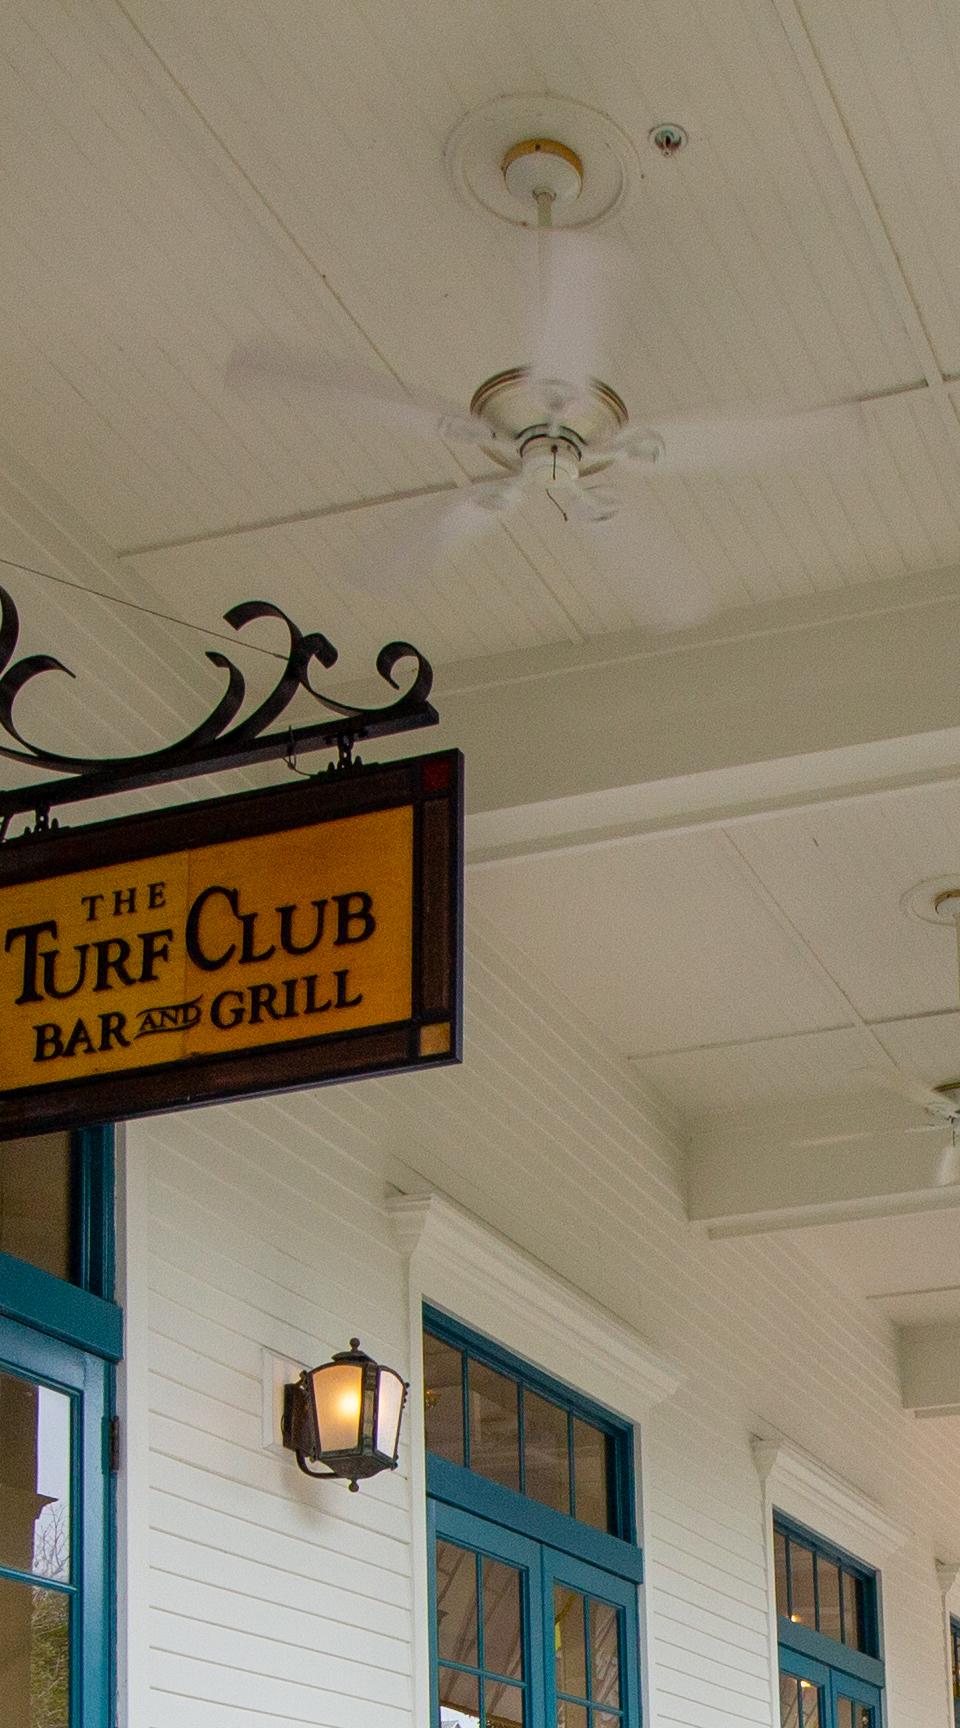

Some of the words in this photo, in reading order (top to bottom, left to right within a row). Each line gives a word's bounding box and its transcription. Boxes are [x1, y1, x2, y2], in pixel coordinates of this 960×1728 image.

[81, 881, 167, 922] THE
[32, 1011, 131, 1063] BAR
[140, 1004, 200, 1033] AND
[209, 969, 363, 1030] GRILL
